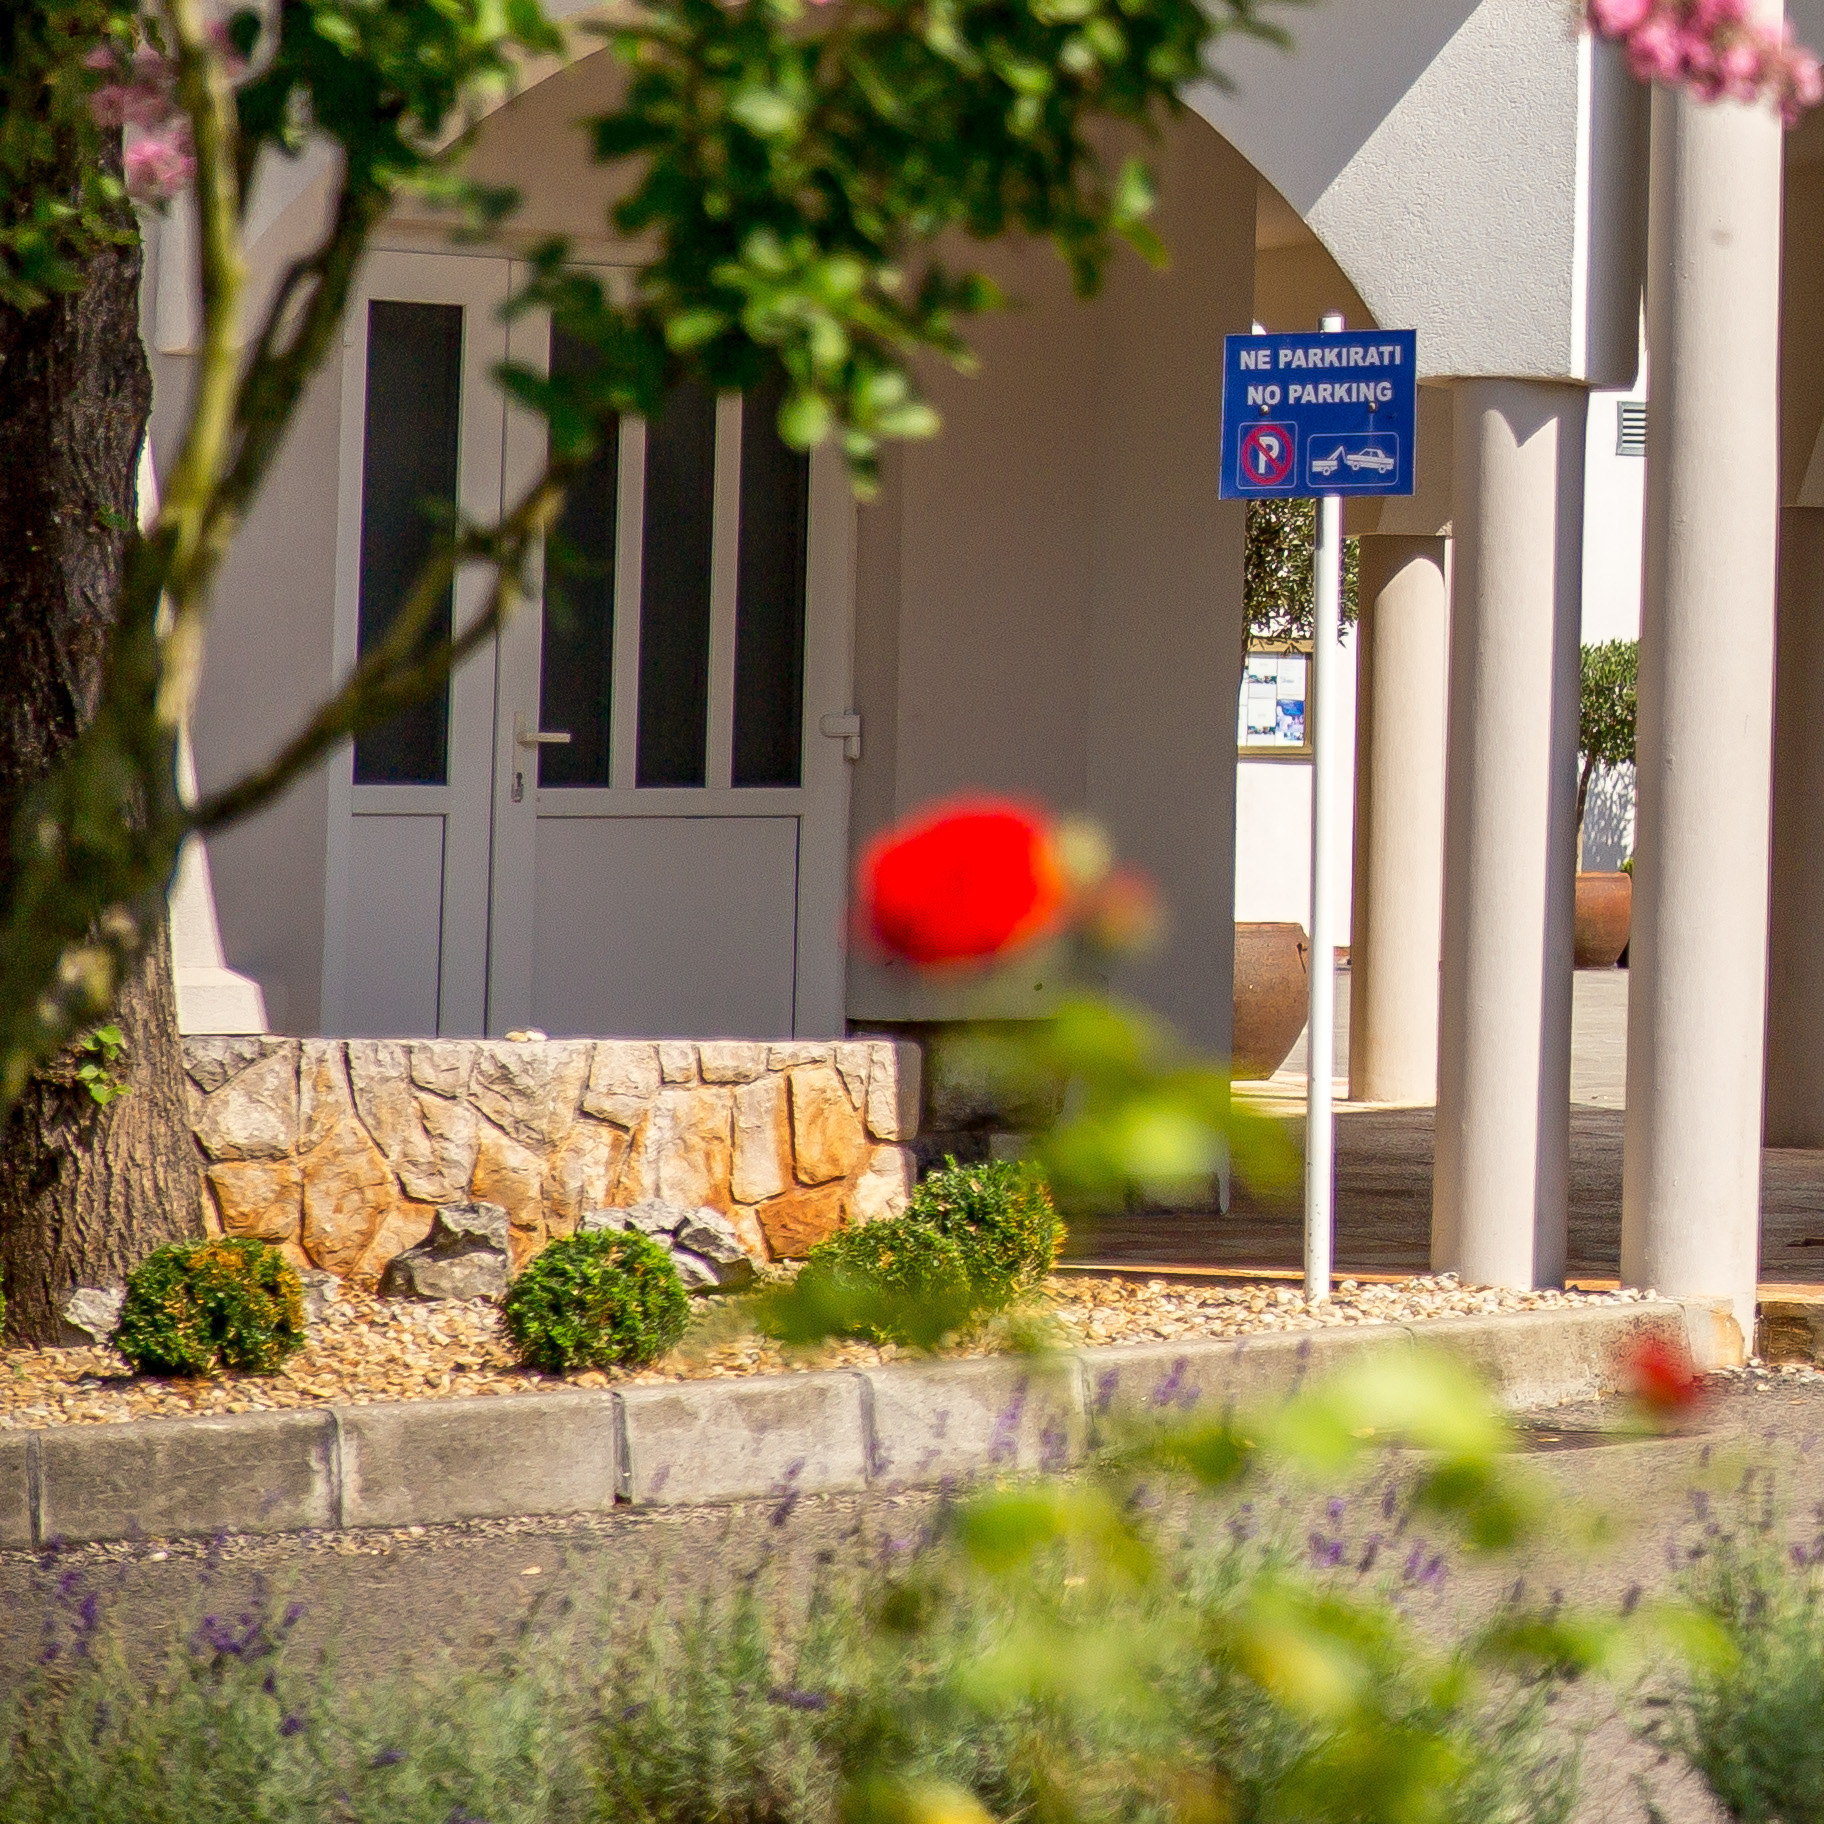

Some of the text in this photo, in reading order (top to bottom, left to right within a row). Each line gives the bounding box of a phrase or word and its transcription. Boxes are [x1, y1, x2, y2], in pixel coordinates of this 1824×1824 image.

[1239, 345, 1401, 370] NE PARKIRATI
[1247, 381, 1393, 405] NO PARKING
